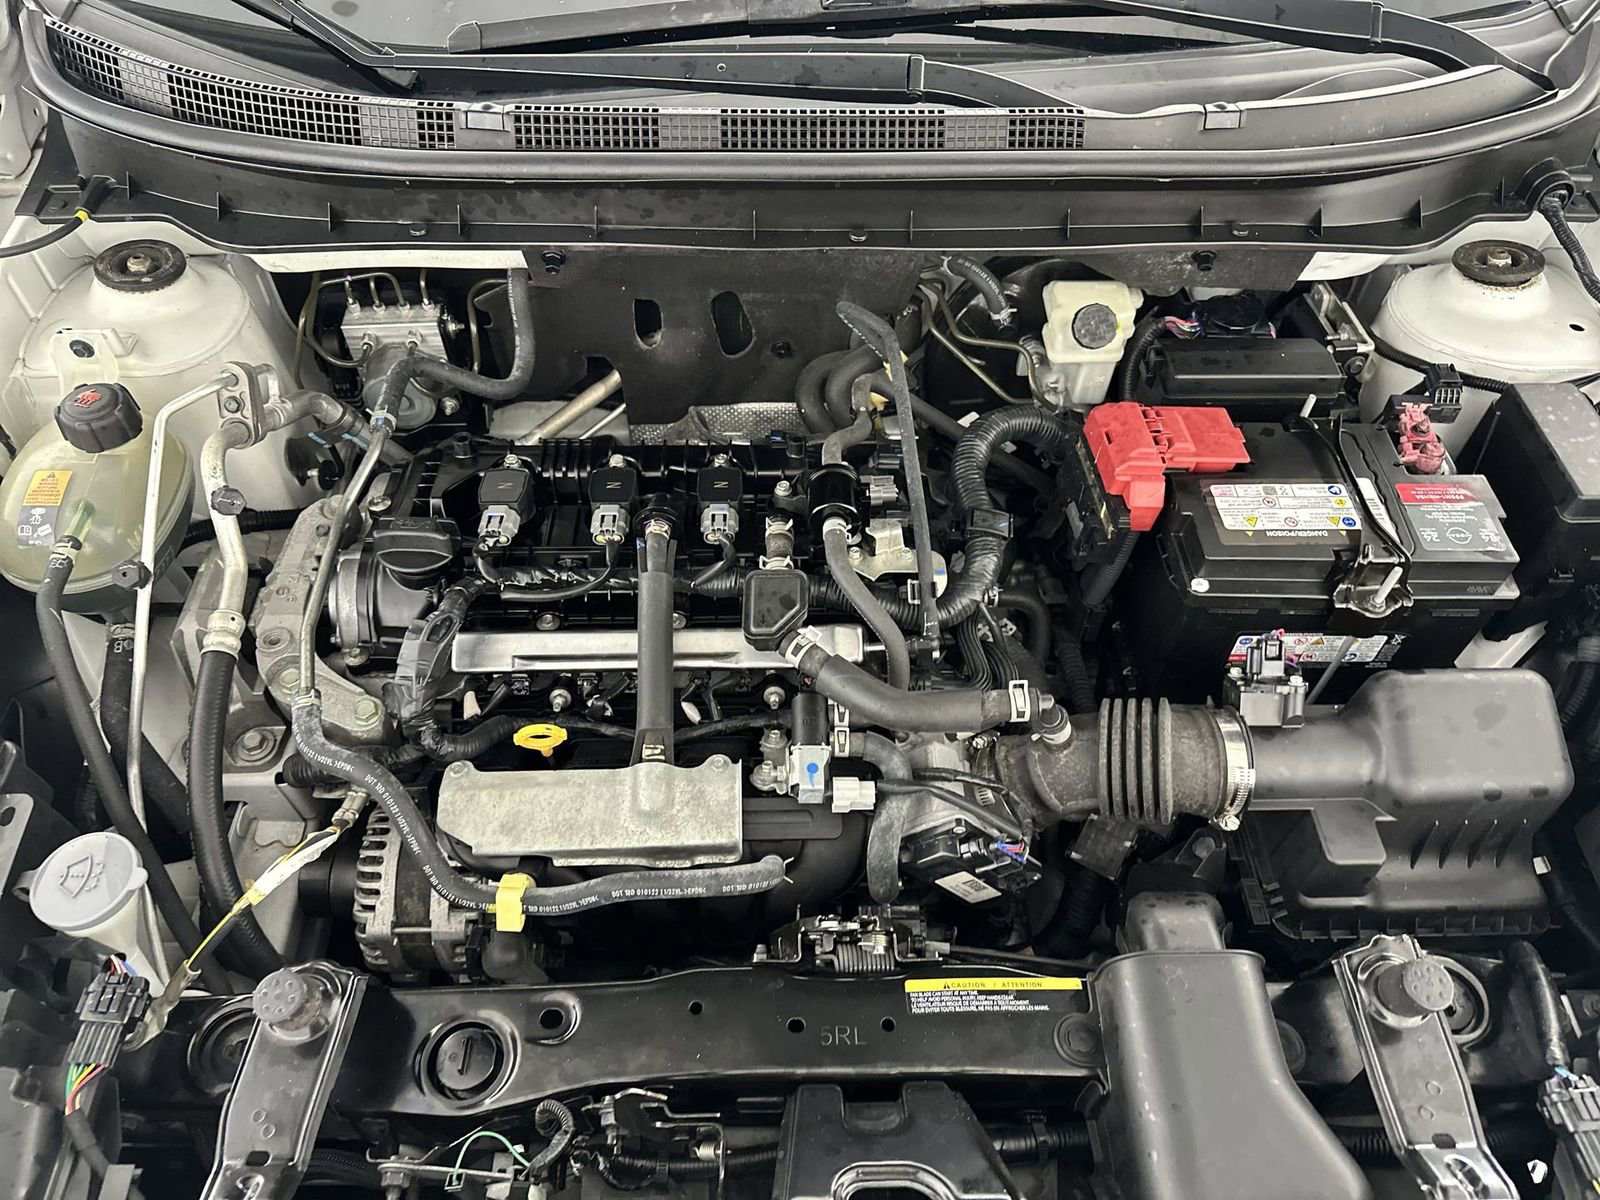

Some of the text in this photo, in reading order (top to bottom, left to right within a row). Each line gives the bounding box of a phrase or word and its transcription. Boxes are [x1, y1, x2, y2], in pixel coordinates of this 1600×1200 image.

[383, 790, 399, 812] 010122
[436, 884, 455, 902] 010122
[636, 887, 659, 897] 010122
[951, 981, 986, 989] CAUTION
[820, 1025, 867, 1046] 5RL
